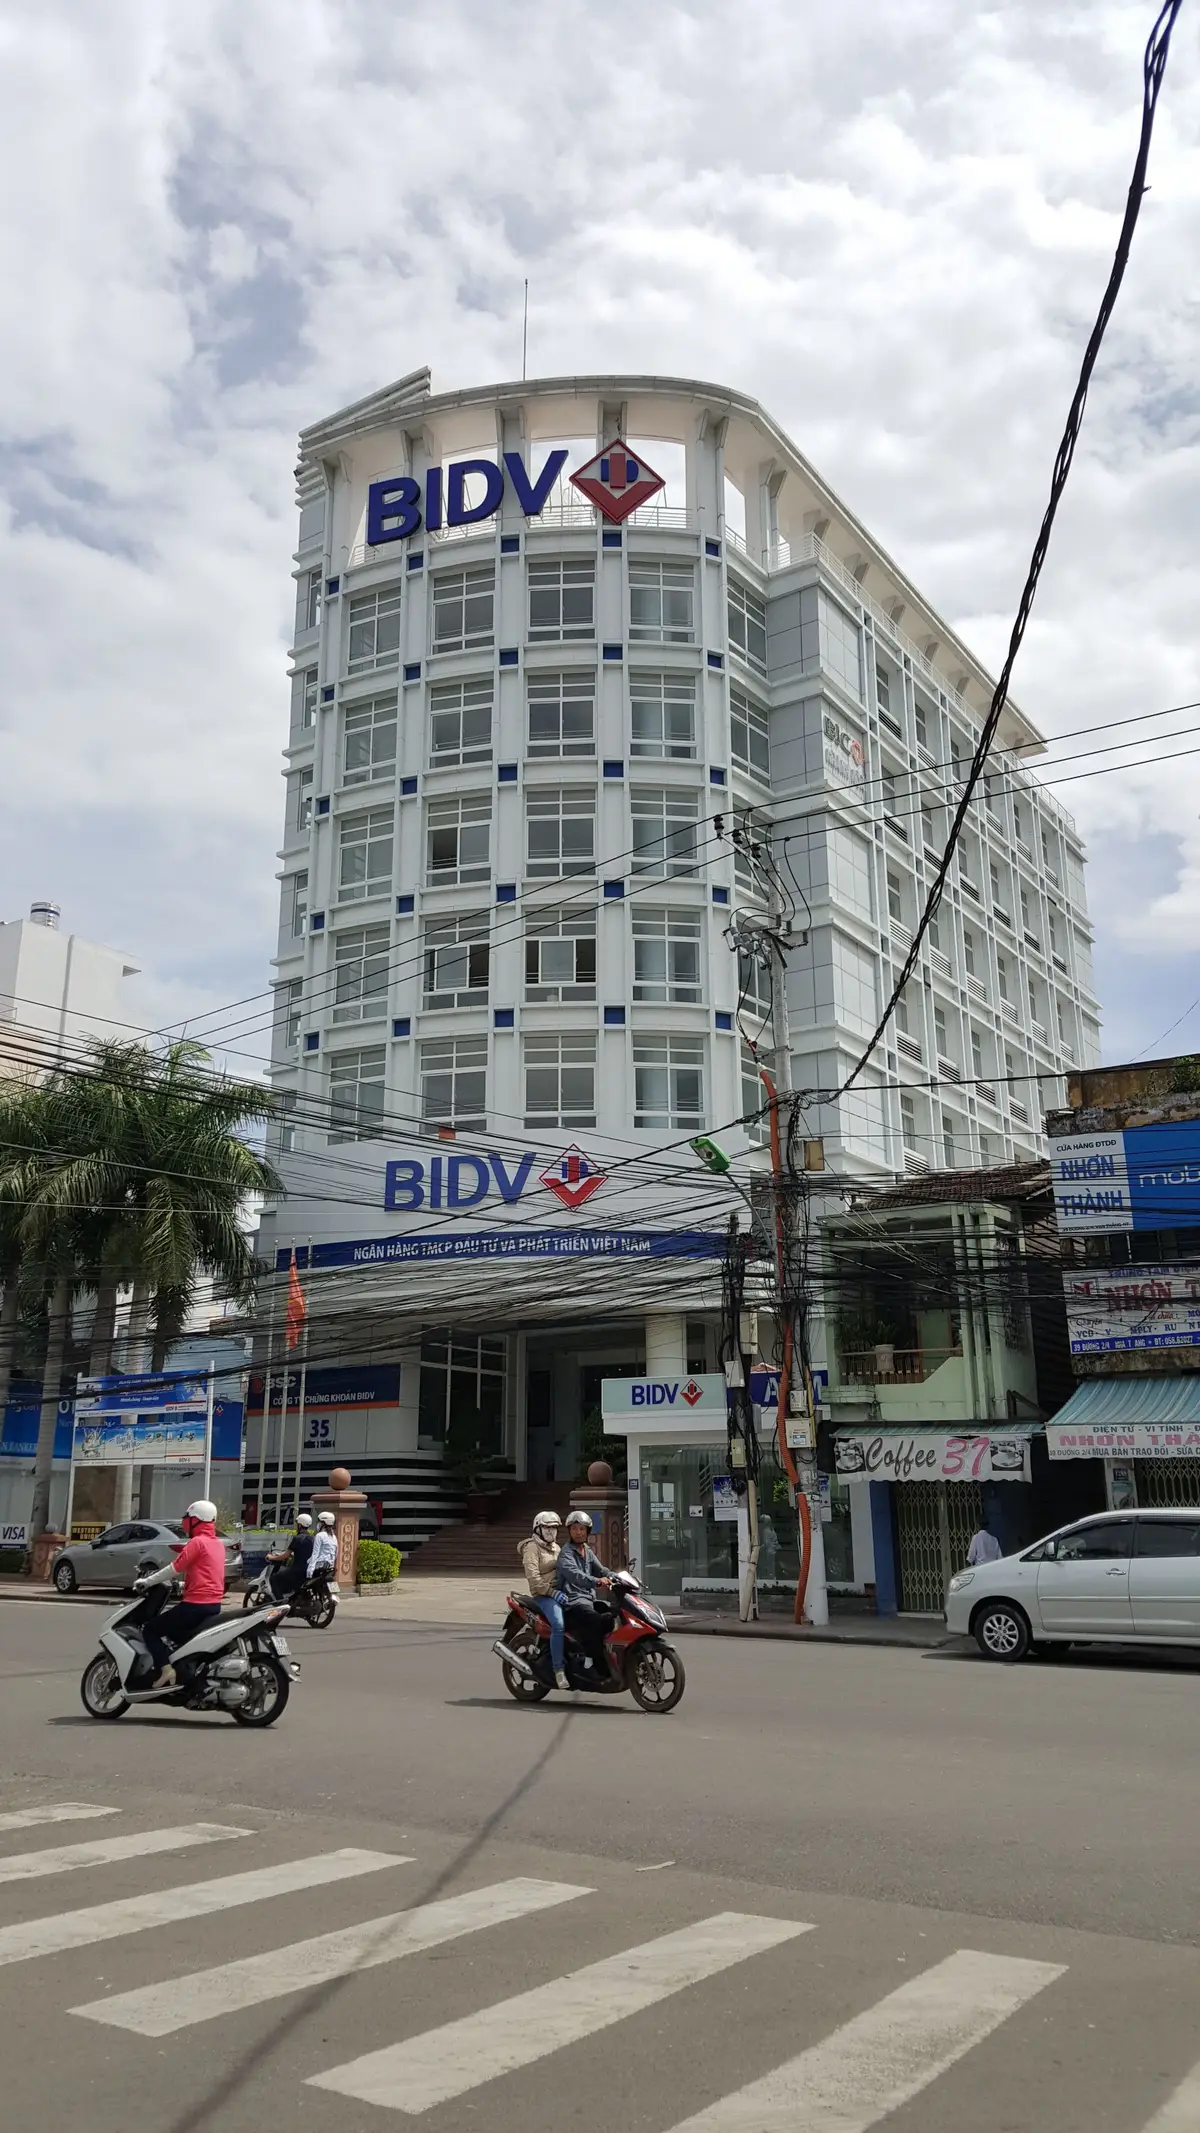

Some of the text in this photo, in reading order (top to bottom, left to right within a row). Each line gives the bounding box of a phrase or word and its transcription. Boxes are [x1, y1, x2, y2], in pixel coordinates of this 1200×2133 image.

[367, 449, 569, 546] BIDV
[1073, 1141, 1094, 1150] HÀNG
[1095, 1139, 1117, 1148] ĐTDĐ
[384, 1152, 537, 1212] BIDV
[1057, 1188, 1124, 1217] THÀNH
[354, 1246, 385, 1260] NGÂN
[387, 1242, 419, 1258] HÀNG
[422, 1242, 452, 1256] TMCP
[500, 1236, 517, 1252] VÀ
[518, 1234, 550, 1252] PHÁT
[591, 1235, 619, 1255] VIỆT
[621, 1238, 651, 1252] NAM
[272, 1395, 293, 1406] CÔG
[305, 1393, 330, 1404] CHỨNG
[330, 1389, 357, 1402] KHOÁN
[357, 1391, 376, 1401] BIDV
[631, 1383, 679, 1406] BIDV
[309, 1419, 330, 1438] 35
[1092, 1426, 1118, 1434] ĐIỆN
[1058, 1433, 1135, 1446] NHƠN
[866, 1436, 991, 1477] Coffee 37
[1092, 1448, 1110, 1456] MUA
[1130, 1447, 1152, 1456] TRAO
[2, 1526, 25, 1540] VISA
